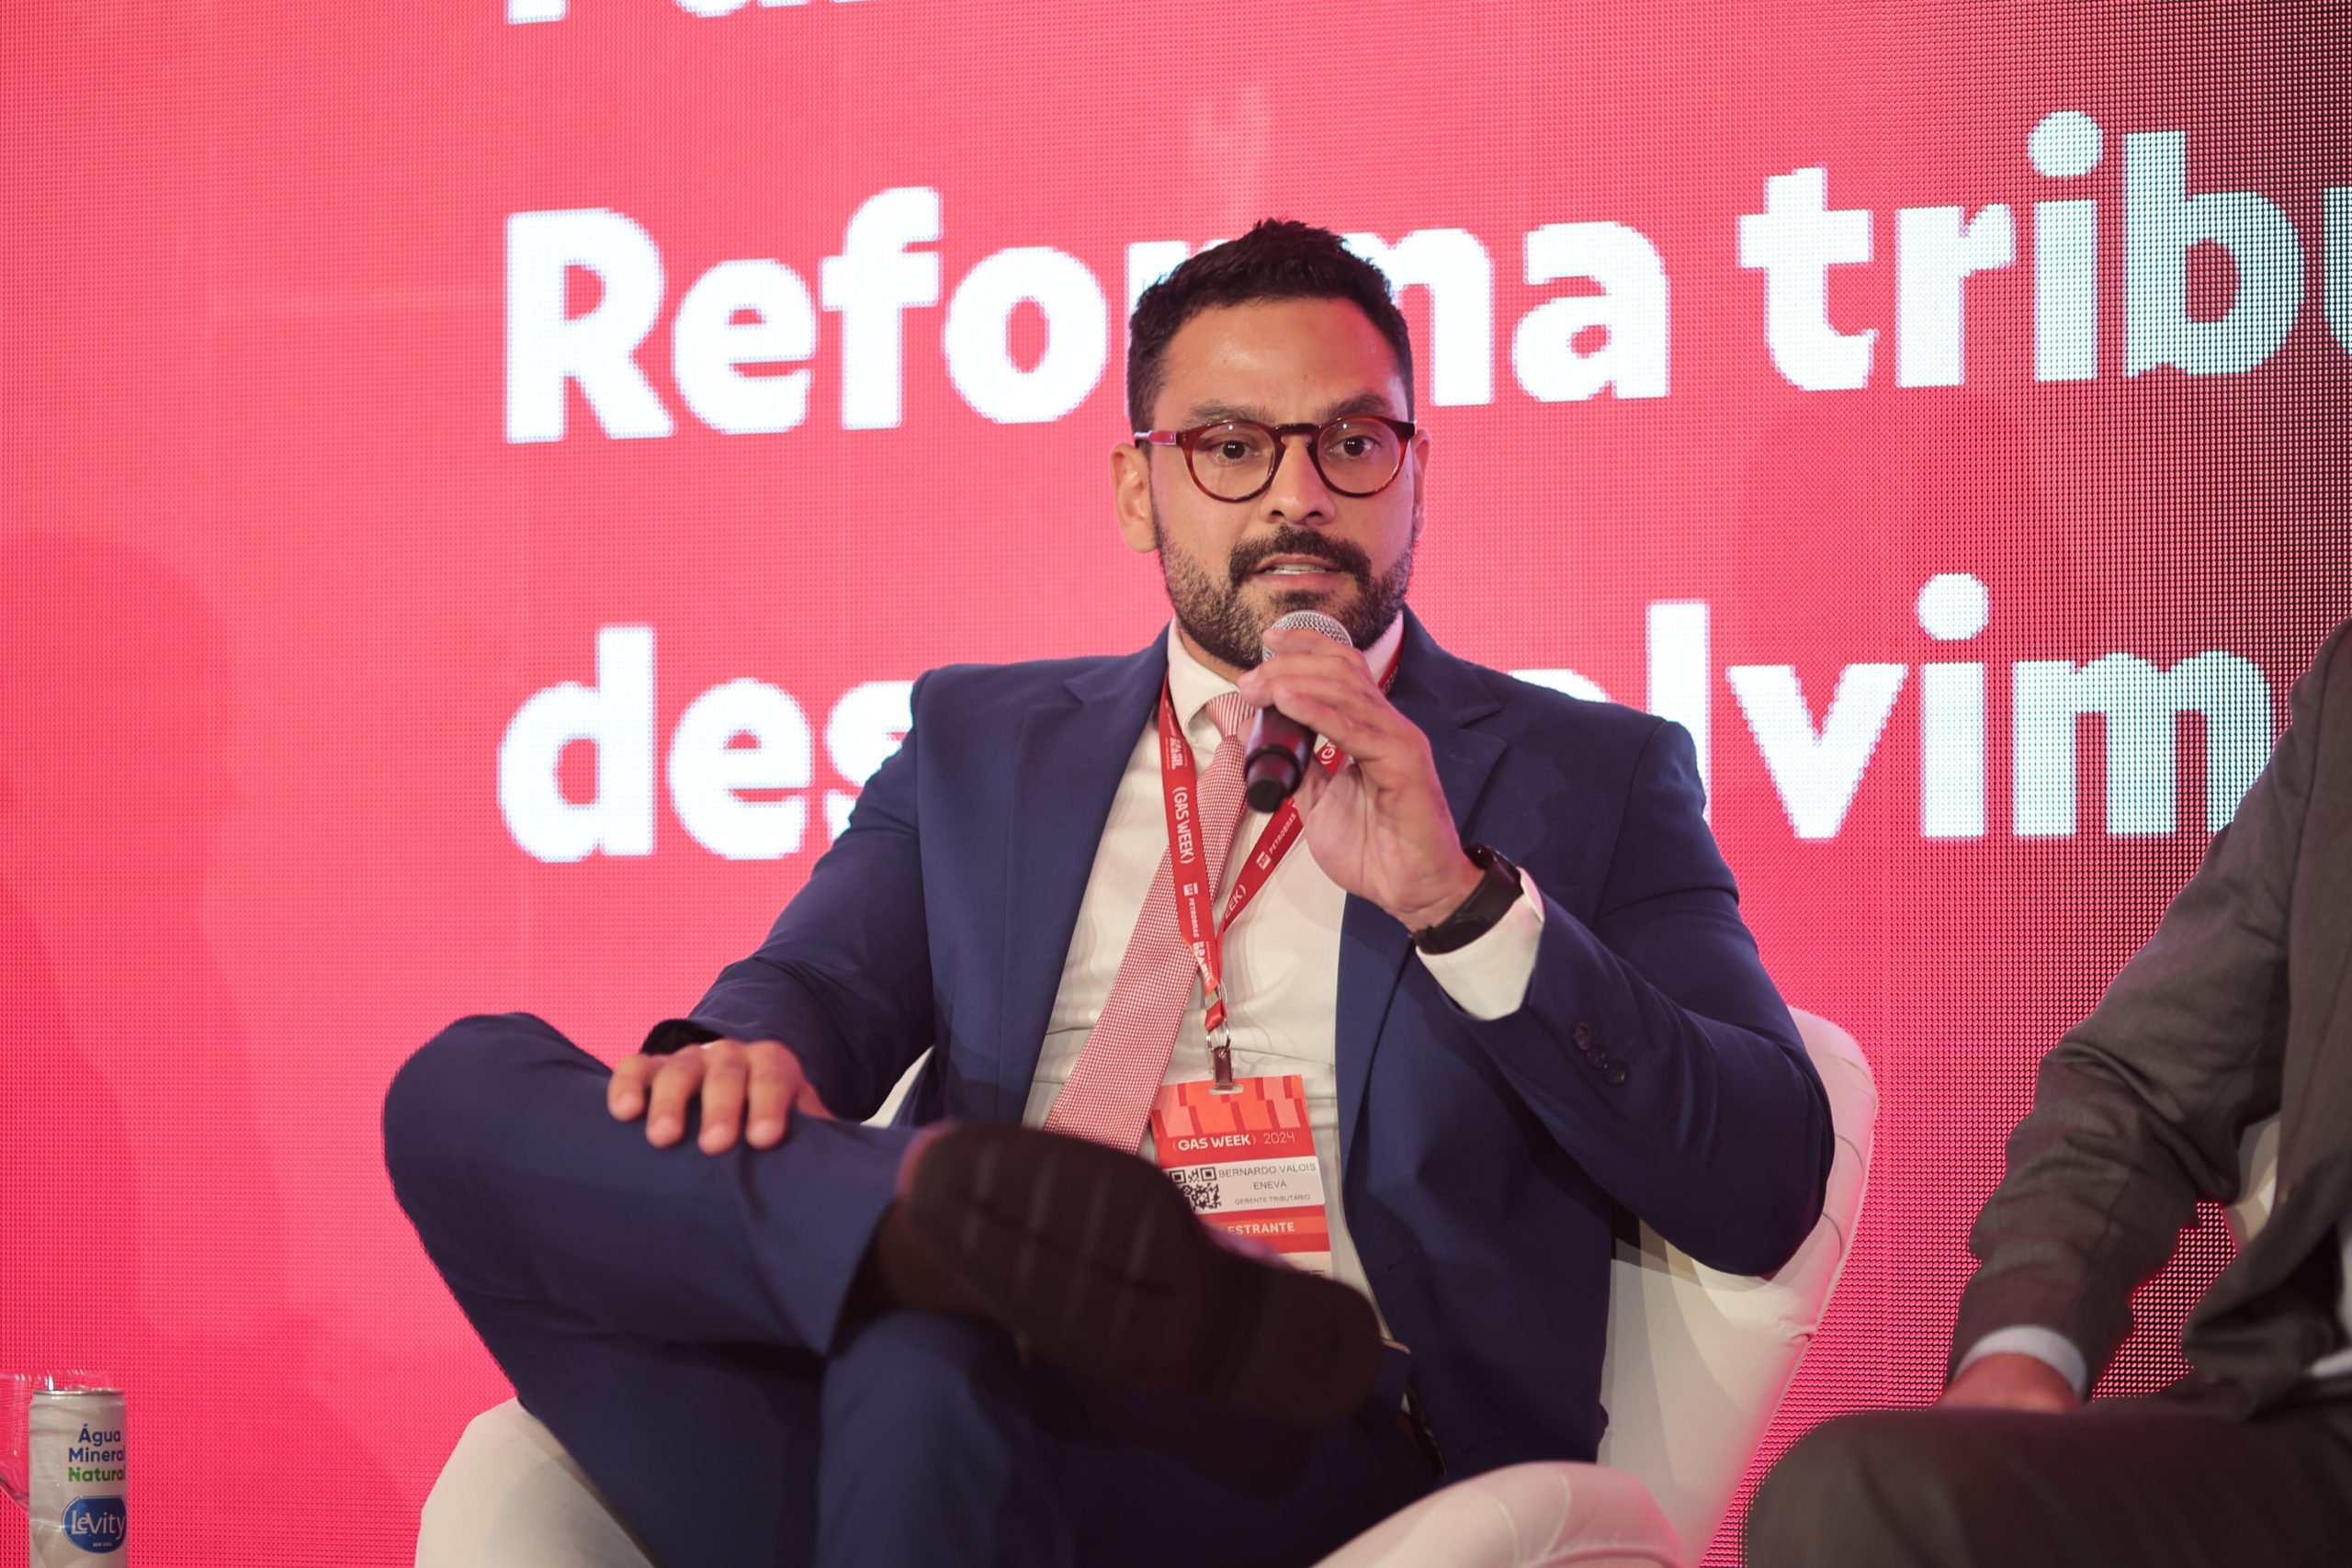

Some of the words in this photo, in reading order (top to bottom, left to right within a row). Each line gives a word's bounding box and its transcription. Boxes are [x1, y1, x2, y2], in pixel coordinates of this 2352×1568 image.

[1736, 108, 2352, 391] trib
[1171, 786, 1190, 821] (GAS
[1176, 819, 1195, 864] WEEK)
[1269, 812, 1297, 855] PETROBRAS
[1224, 884, 1248, 920] EEK)
[1188, 897, 1200, 938] PETROBRAS
[1263, 1131, 1295, 1145] 2024
[1218, 1165, 1277, 1179] BERNARDO
[1279, 1162, 1317, 1174] VALOIS
[1253, 1180, 1287, 1190] ENEVA
[1235, 1196, 1267, 1205] GERENTE
[1270, 1193, 1310, 1202] TRIBUTÁRIO
[1226, 1222, 1295, 1235] ESTRANTE
[78, 1423, 121, 1447] Água
[68, 1445, 126, 1462] Mineral
[68, 1464, 126, 1482] Natural
